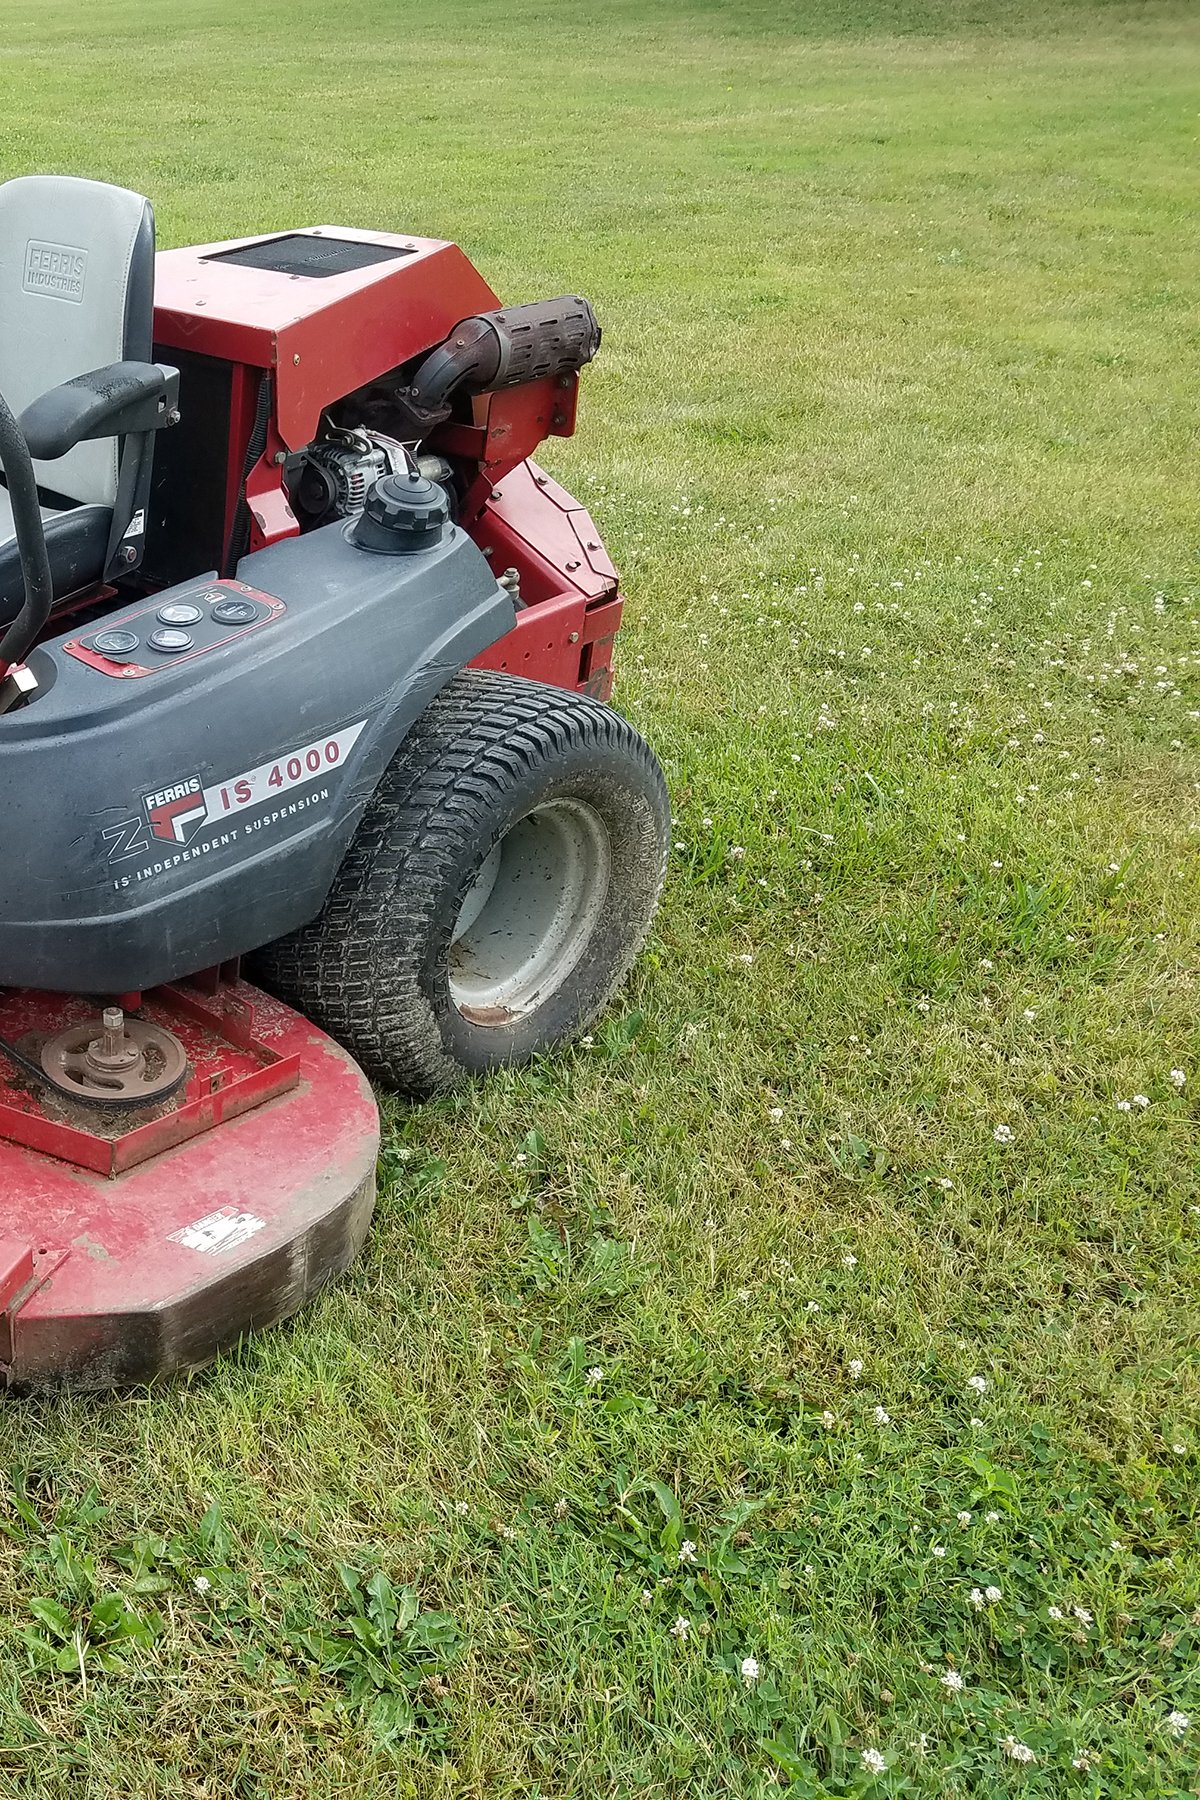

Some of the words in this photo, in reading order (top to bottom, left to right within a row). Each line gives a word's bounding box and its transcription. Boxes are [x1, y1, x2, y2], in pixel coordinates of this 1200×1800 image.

[30, 248, 84, 280] FERRIS
[27, 271, 82, 294] INDUSTRIES
[267, 740, 340, 788] 4000
[145, 778, 201, 811] FERRIS
[136, 830, 239, 881] INDEPENDENT
[245, 788, 329, 834] SUSPENSION
